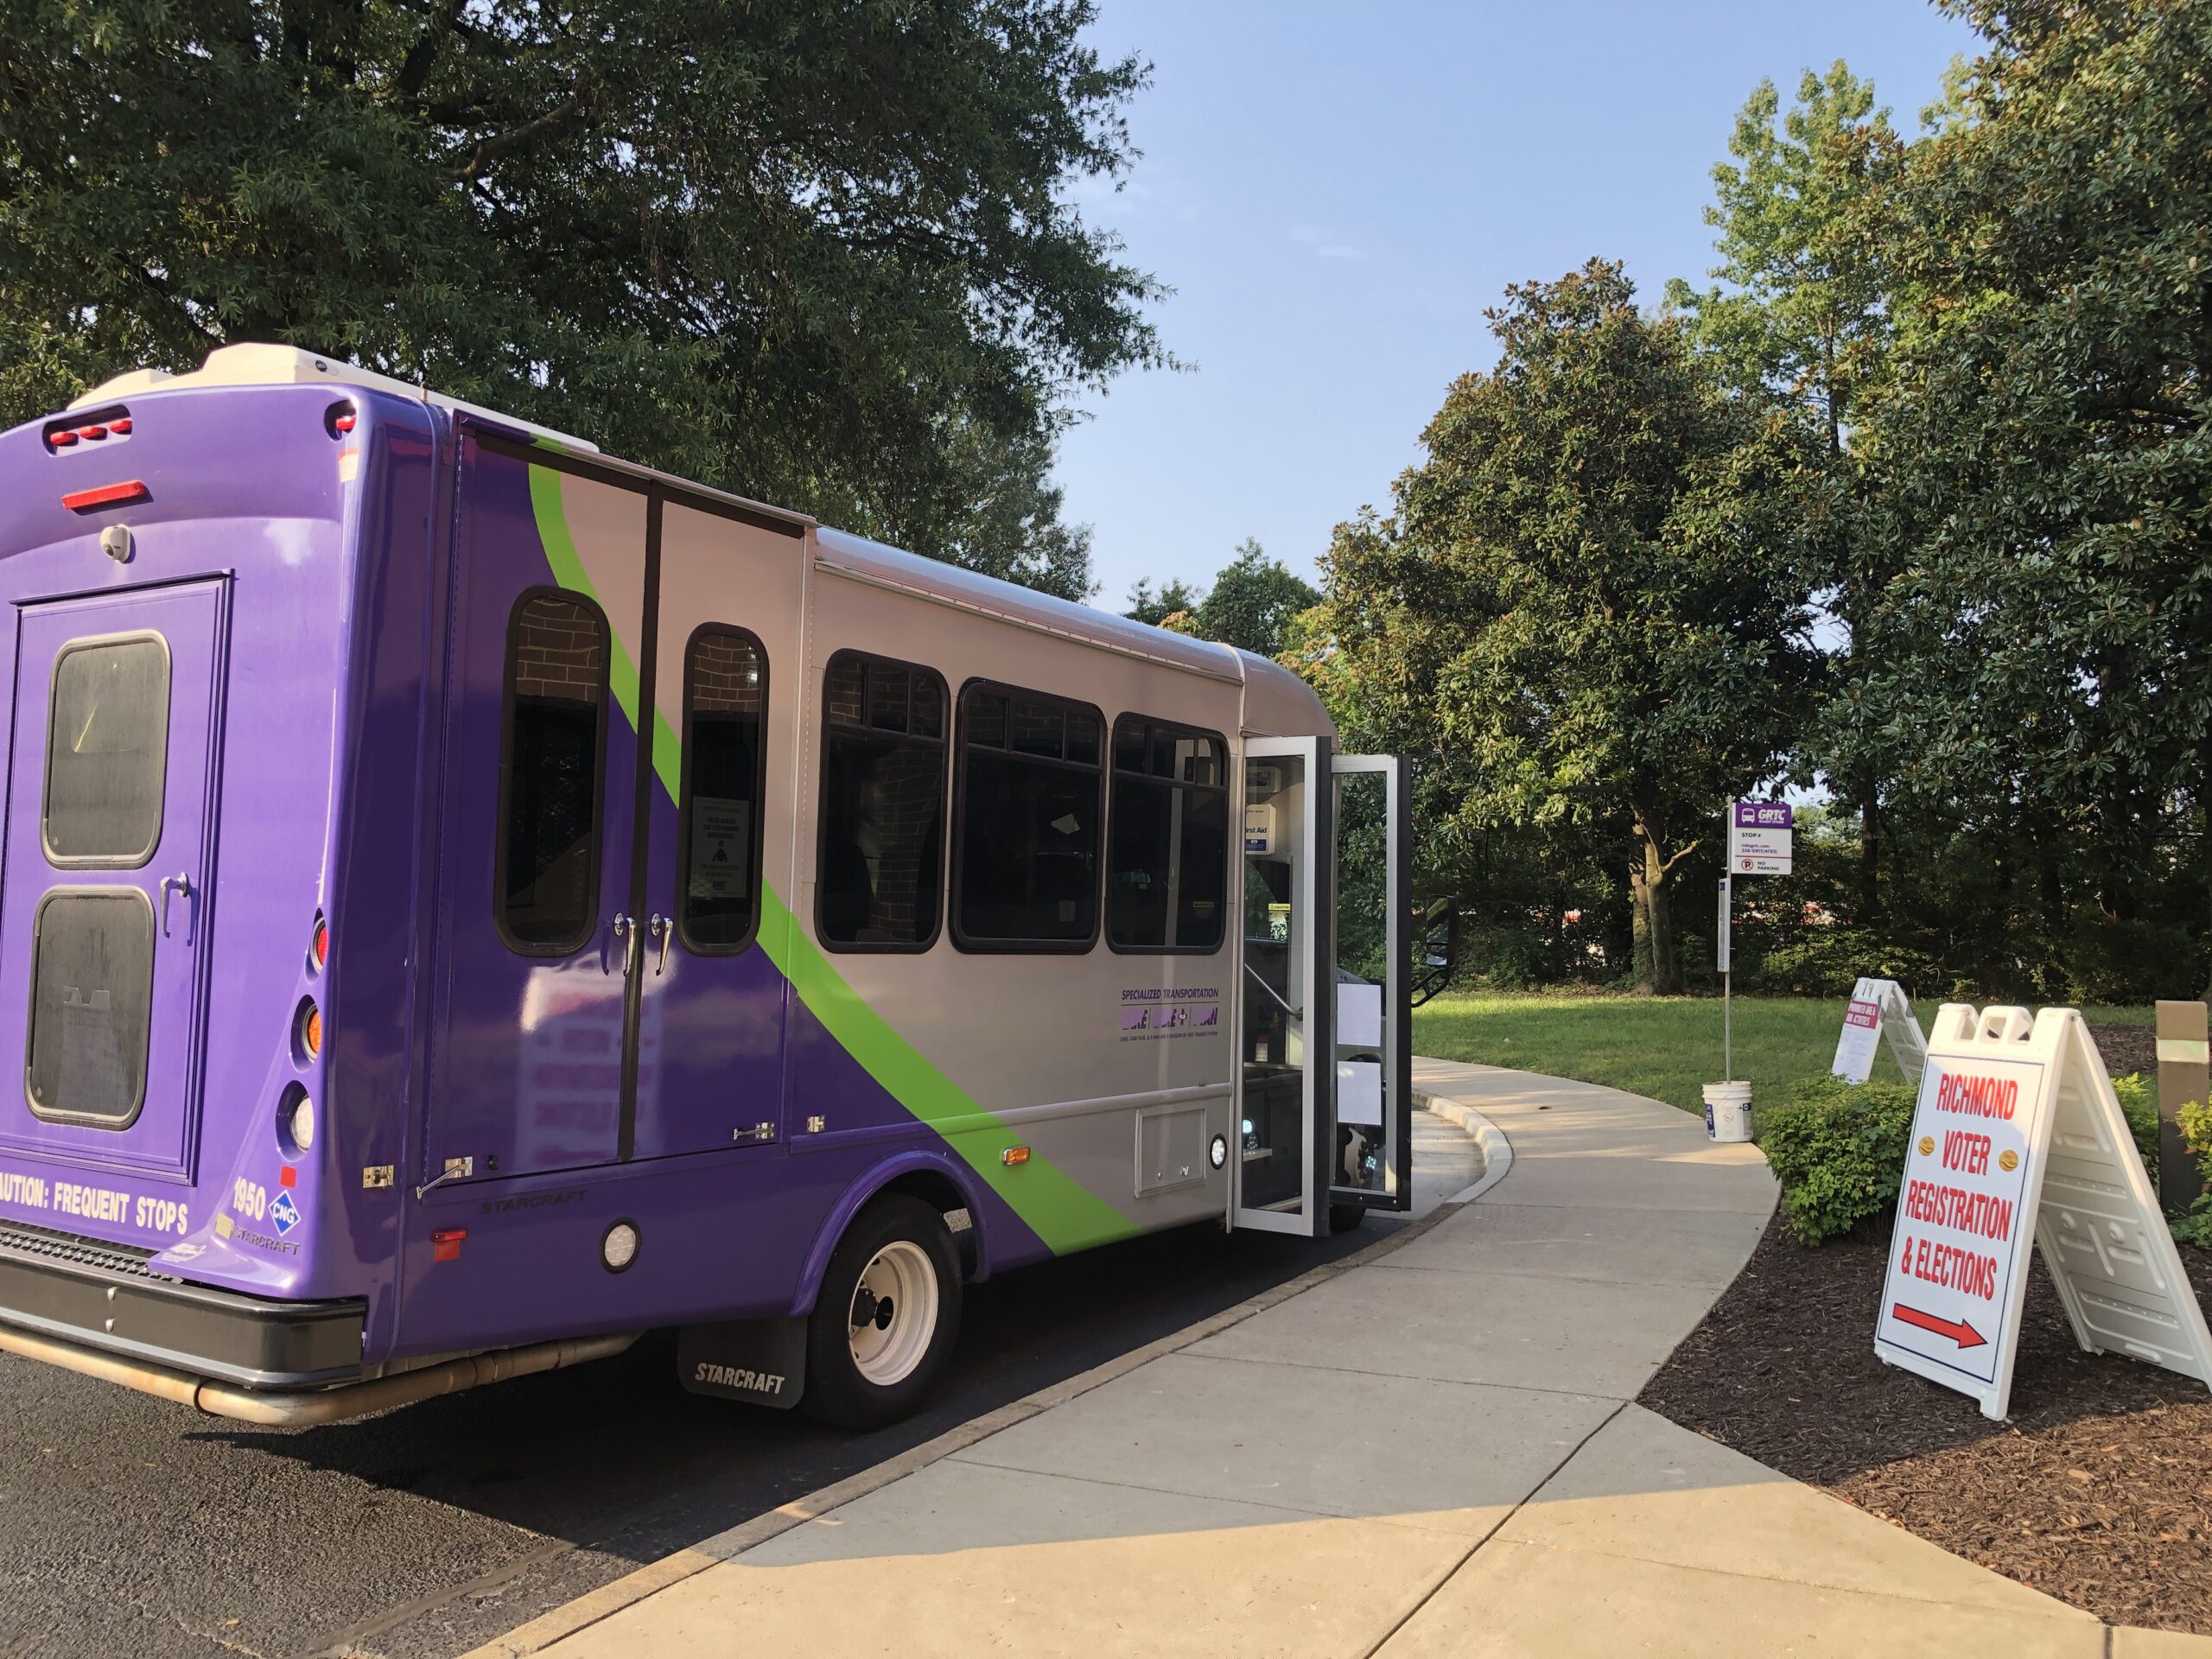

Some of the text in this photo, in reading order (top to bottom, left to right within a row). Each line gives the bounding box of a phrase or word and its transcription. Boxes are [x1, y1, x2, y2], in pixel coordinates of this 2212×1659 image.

[1758, 809, 1786, 821] GRTC
[1122, 988, 1219, 1000] SPECIALIZED TRANSPORTATION
[1936, 1073, 2018, 1121] RICHMOND
[1942, 1129, 1992, 1176] VOTER
[0, 1172, 188, 1236] AUTION: FREQUENT STOPS
[233, 1176, 266, 1221] 1950
[272, 1202, 295, 1224] CNG
[480, 1190, 588, 1215] STARCRAFT
[1905, 1179, 2012, 1242] REGISTRATION
[233, 1226, 301, 1255] STARCRAFT
[1901, 1236, 1997, 1300] & ELECTIONS
[695, 1363, 785, 1395] STARCRAFT
